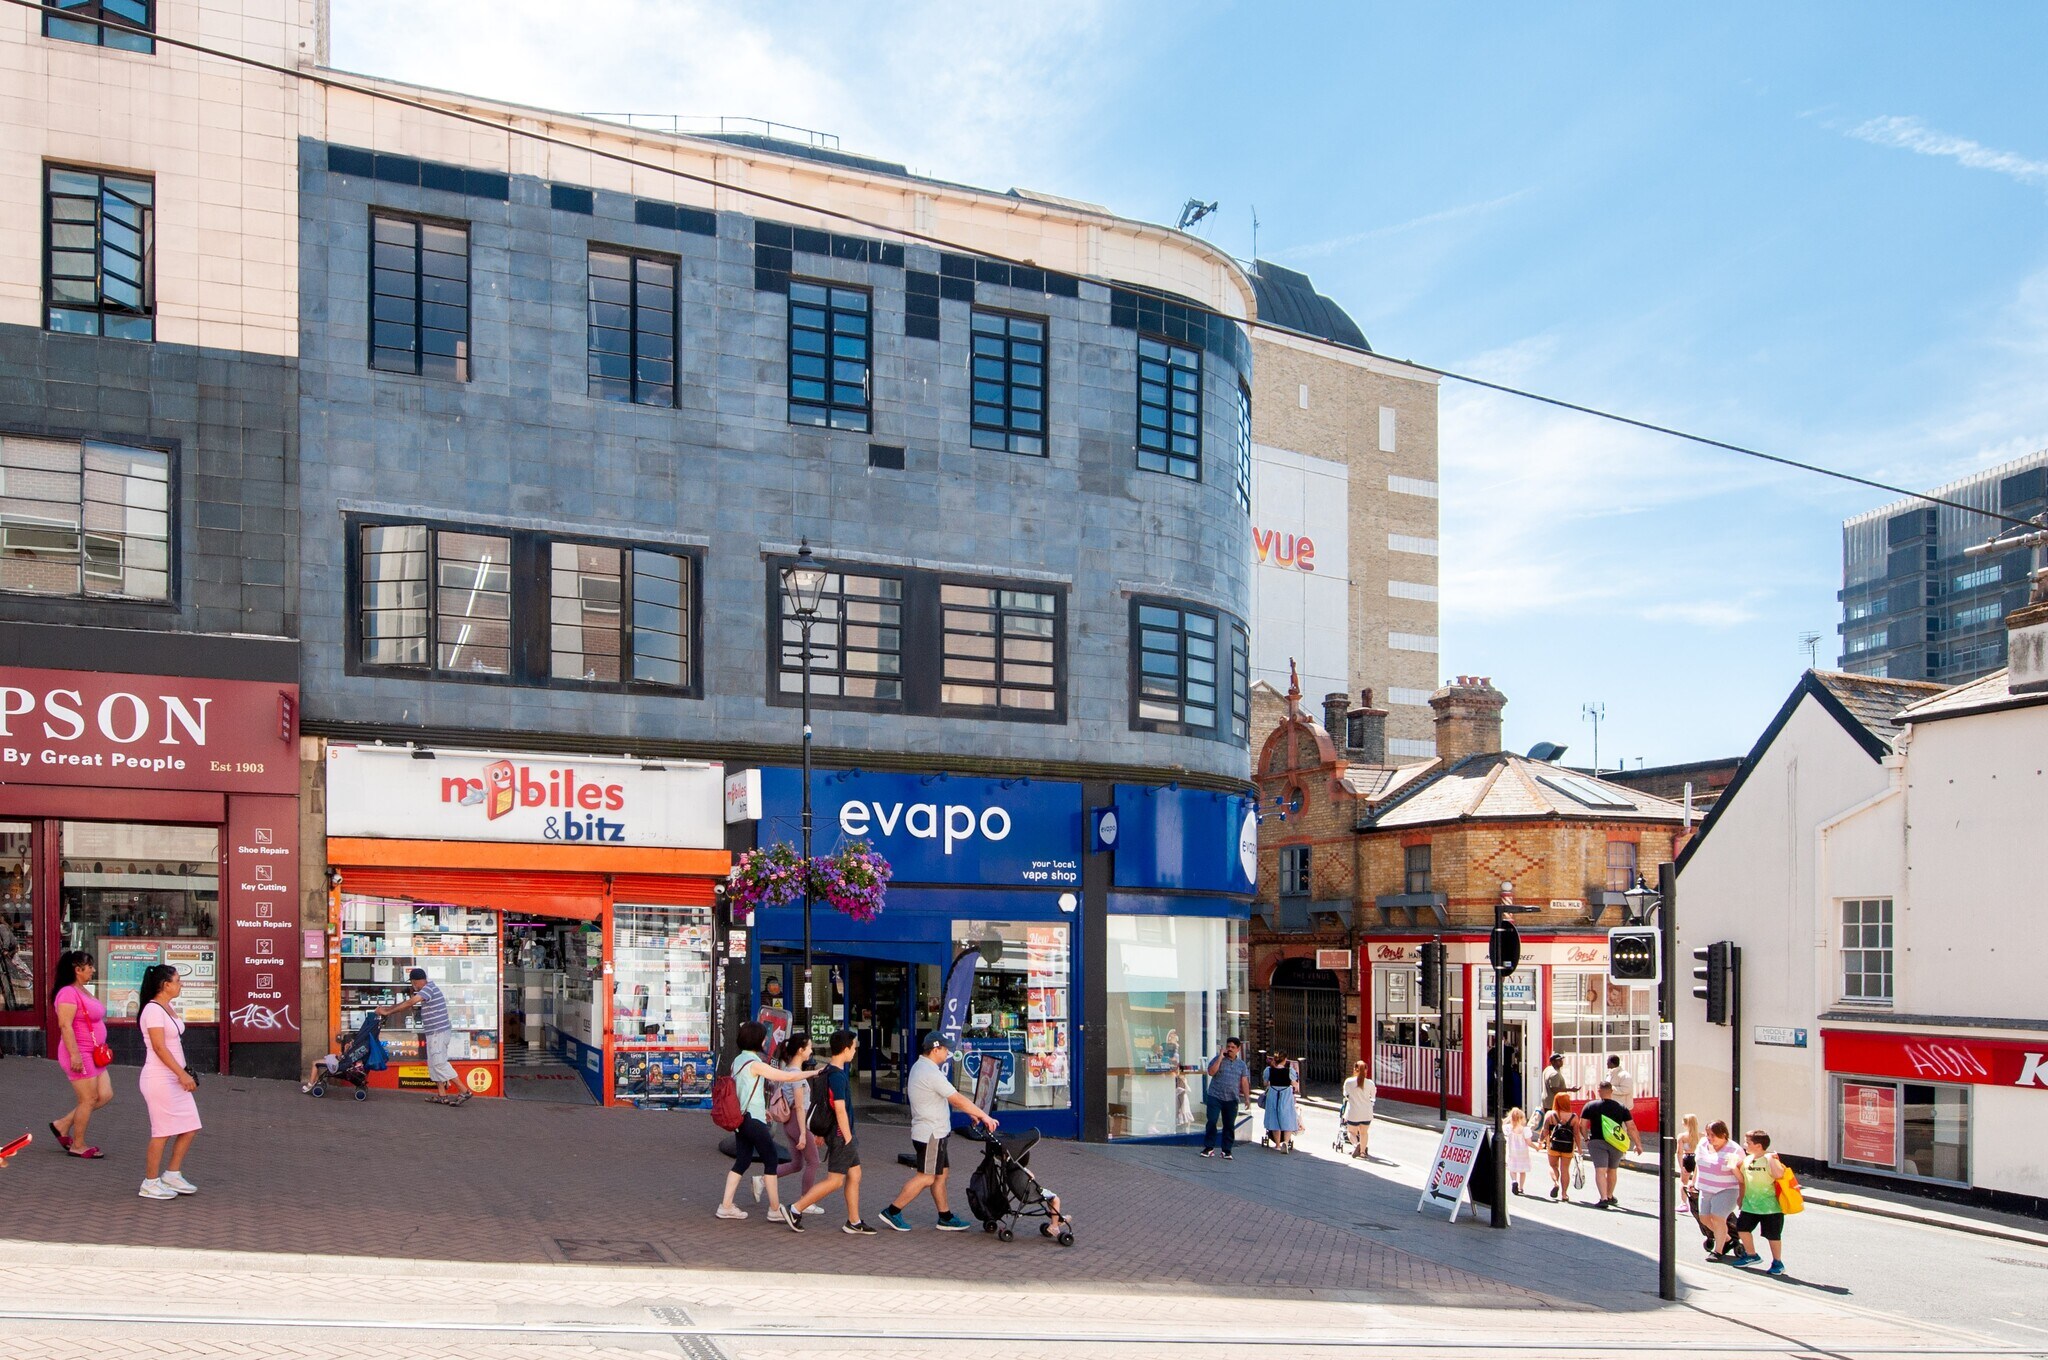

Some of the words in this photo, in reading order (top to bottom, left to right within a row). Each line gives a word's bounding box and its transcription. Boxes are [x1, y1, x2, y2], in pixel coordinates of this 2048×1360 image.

[1252, 526, 1315, 571] vue
[0, 686, 212, 746] PSON
[331, 749, 338, 759] 5
[3, 748, 31, 765] By
[41, 750, 102, 766] Great
[112, 753, 186, 771] People
[210, 761, 231, 772] Est
[236, 763, 264, 773] 1903
[839, 800, 1011, 855] evapo
[1101, 825, 1115, 833] evapo
[238, 846, 258, 854] Shoe
[260, 847, 289, 855] Repairs
[1032, 861, 1051, 869] your
[1053, 860, 1077, 869] local
[1022, 871, 1048, 880] vape
[1051, 870, 1077, 882] shop
[241, 884, 256, 892] Key
[258, 884, 287, 892] Cutting
[237, 920, 261, 928] Watch
[263, 921, 292, 929] Repairs
[245, 957, 284, 965] Engraving
[1490, 975, 1524, 984] TNY
[811, 1025, 835, 1034] CBD
[1762, 1028, 1787, 1036] MIDDLE
[629, 1067, 641, 1075] 120
[1449, 1126, 1478, 1143] TONY'S
[1441, 1145, 1472, 1164] BARBER
[1443, 1172, 1464, 1188] SHOP
